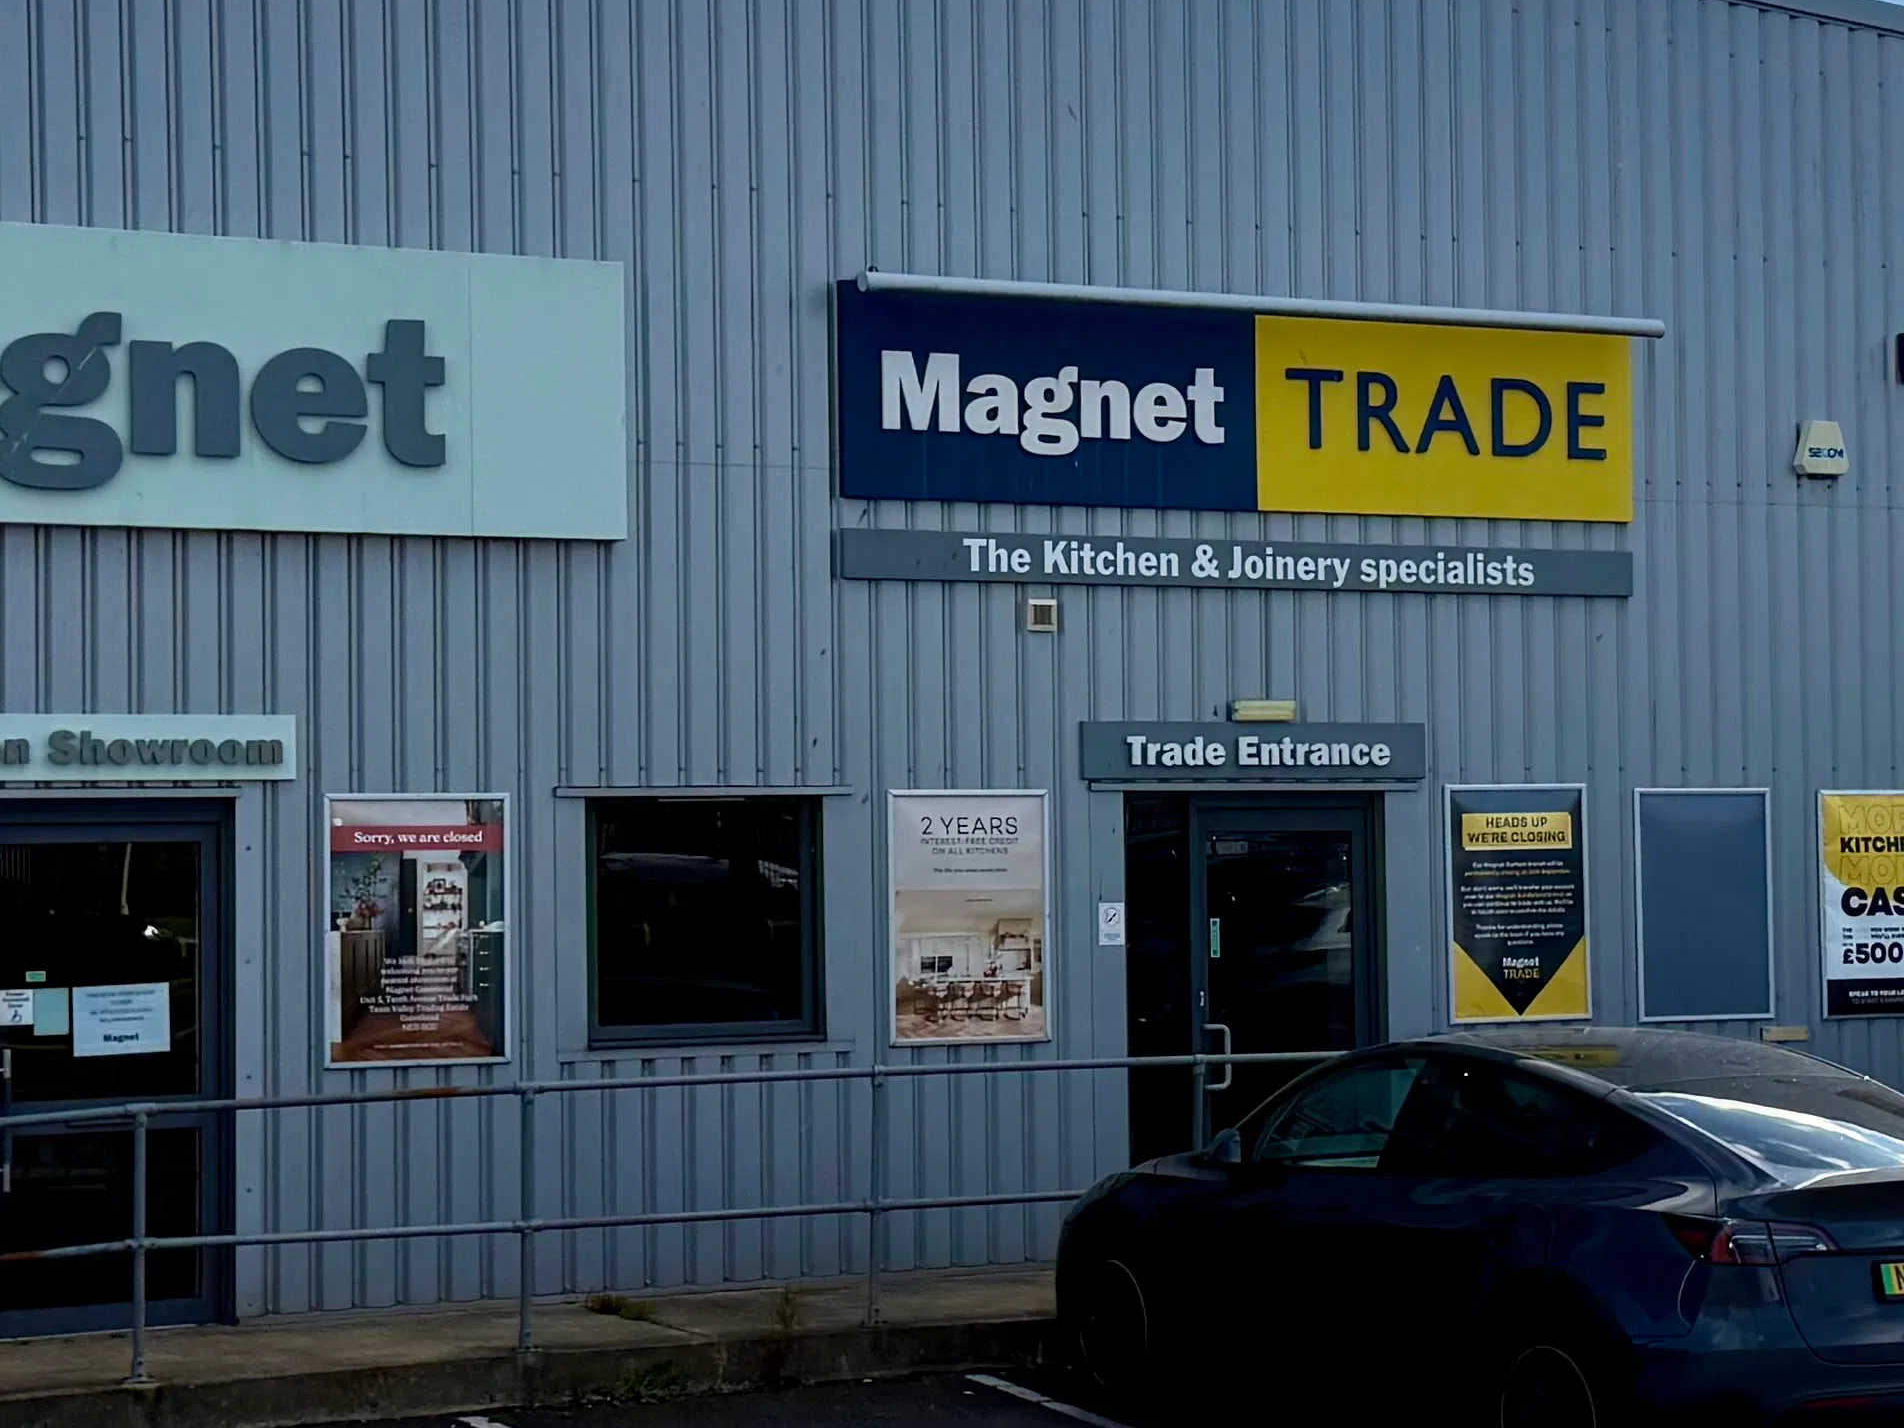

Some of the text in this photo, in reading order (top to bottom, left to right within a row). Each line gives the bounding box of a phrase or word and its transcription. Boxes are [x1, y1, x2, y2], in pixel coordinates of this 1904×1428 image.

[881, 350, 1225, 455] Magnet
[1285, 367, 1607, 460] TRADE
[963, 538, 1535, 588] The Kitchen & Joinery specialists
[47, 729, 284, 766] Showroom
[1126, 735, 1391, 766] Trade Entrance
[921, 816, 1018, 835] 2 YEARS
[1486, 816, 1548, 828] HEADS UP
[354, 830, 482, 845] Sorry, we are closed
[1467, 831, 1566, 844] WE'RE CLOSING
[1502, 956, 1539, 968] Magnet
[1842, 942, 1904, 964] £500
[1503, 968, 1540, 979] TRADE
[103, 1033, 139, 1043] Magnet
